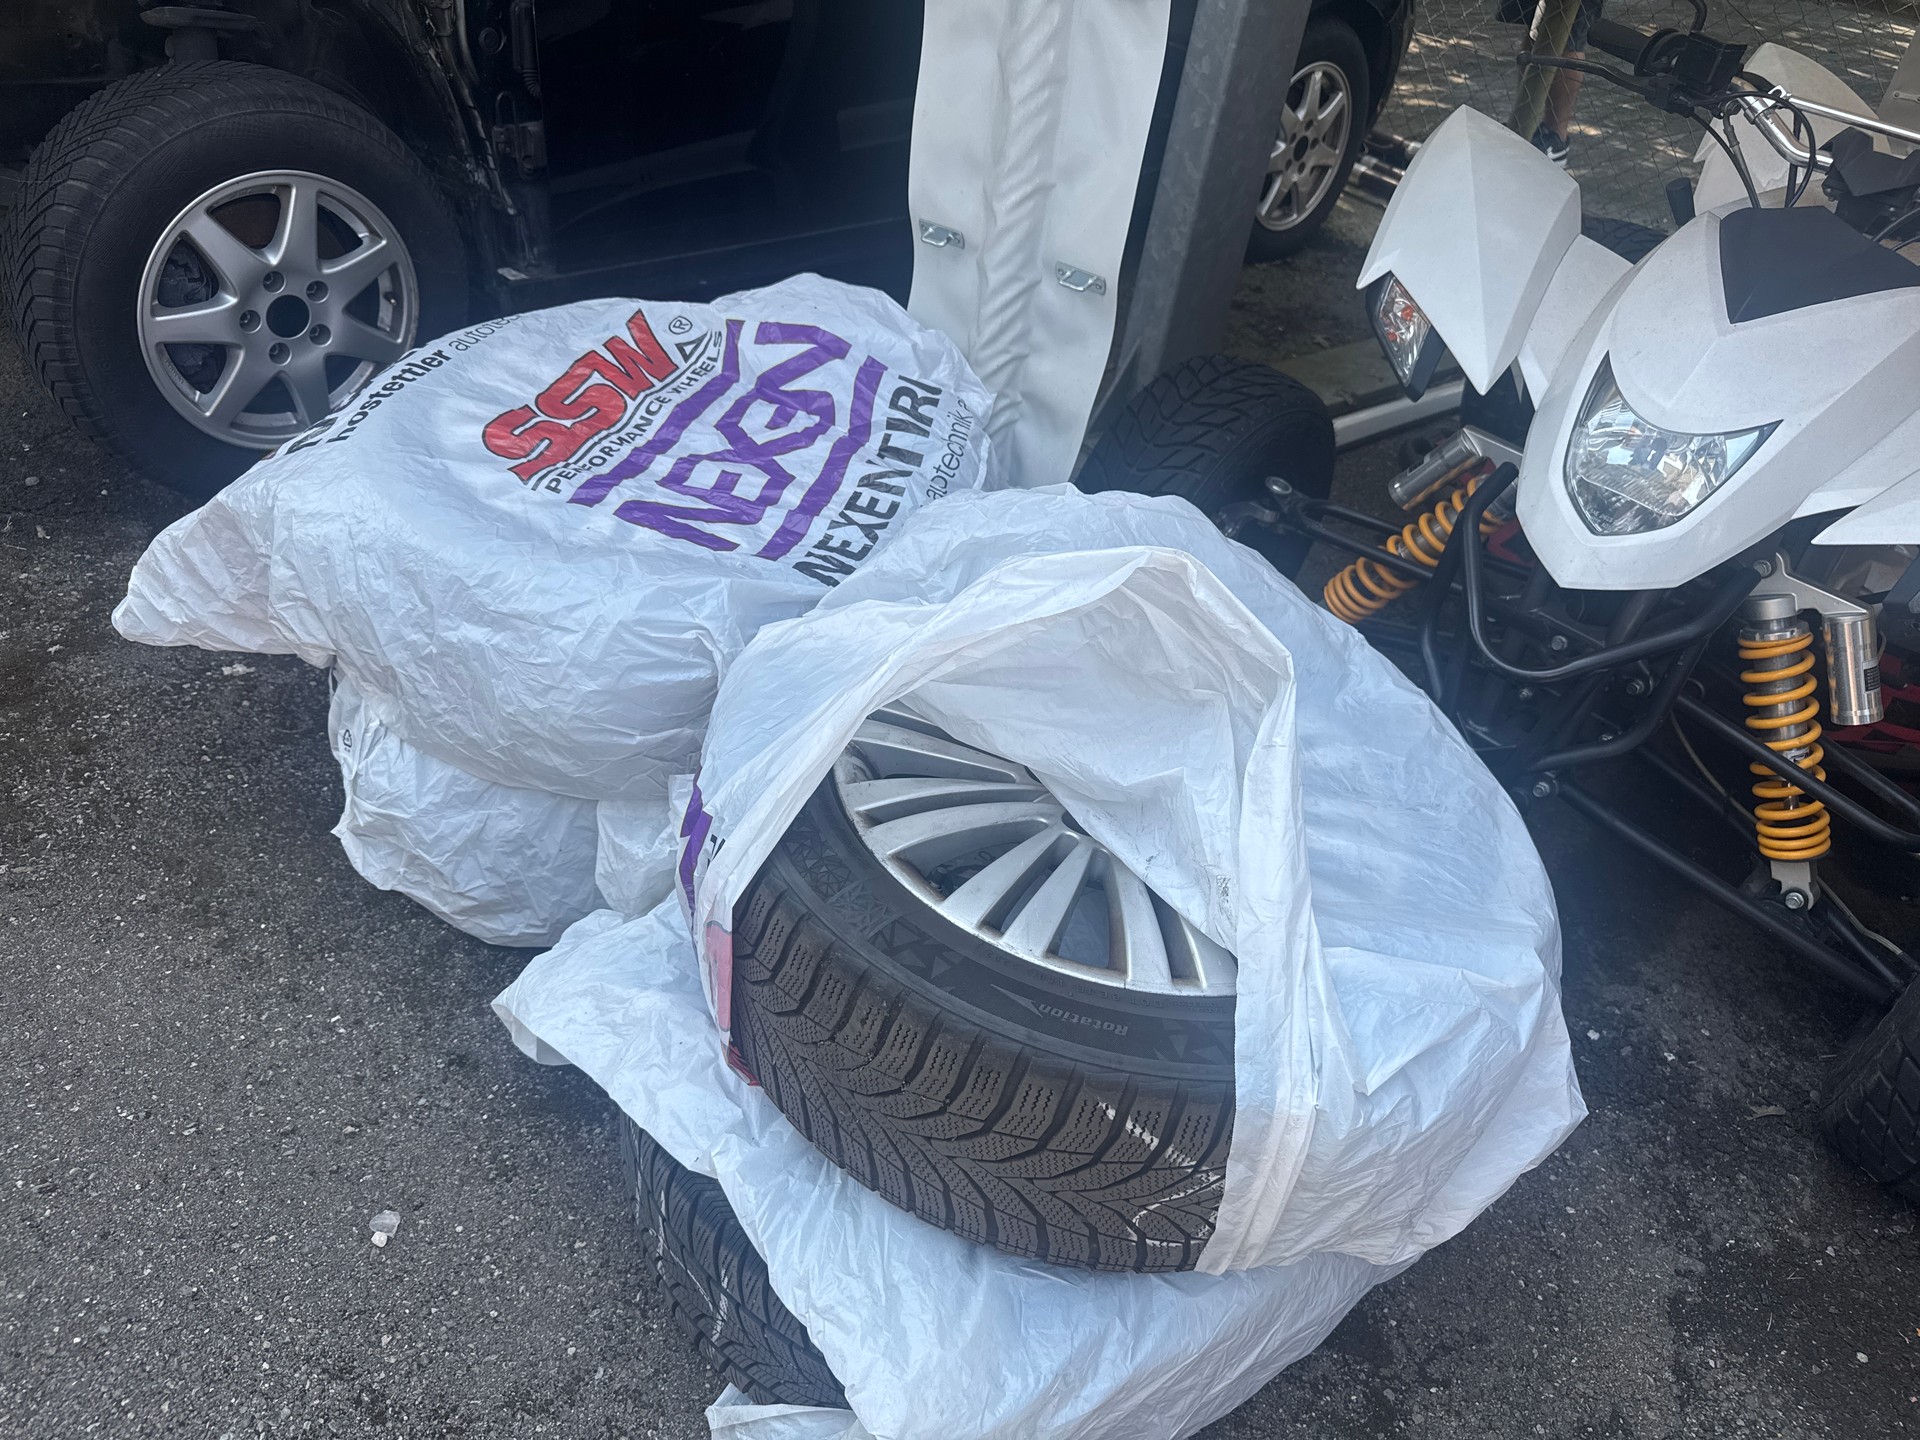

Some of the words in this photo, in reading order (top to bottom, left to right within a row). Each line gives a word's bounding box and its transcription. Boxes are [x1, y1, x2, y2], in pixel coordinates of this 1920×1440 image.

[326, 348, 451, 444] hostettler
[482, 308, 679, 485] SSW
[613, 321, 852, 551] NEXEN
[1038, 1002, 1129, 1037] Rotation
